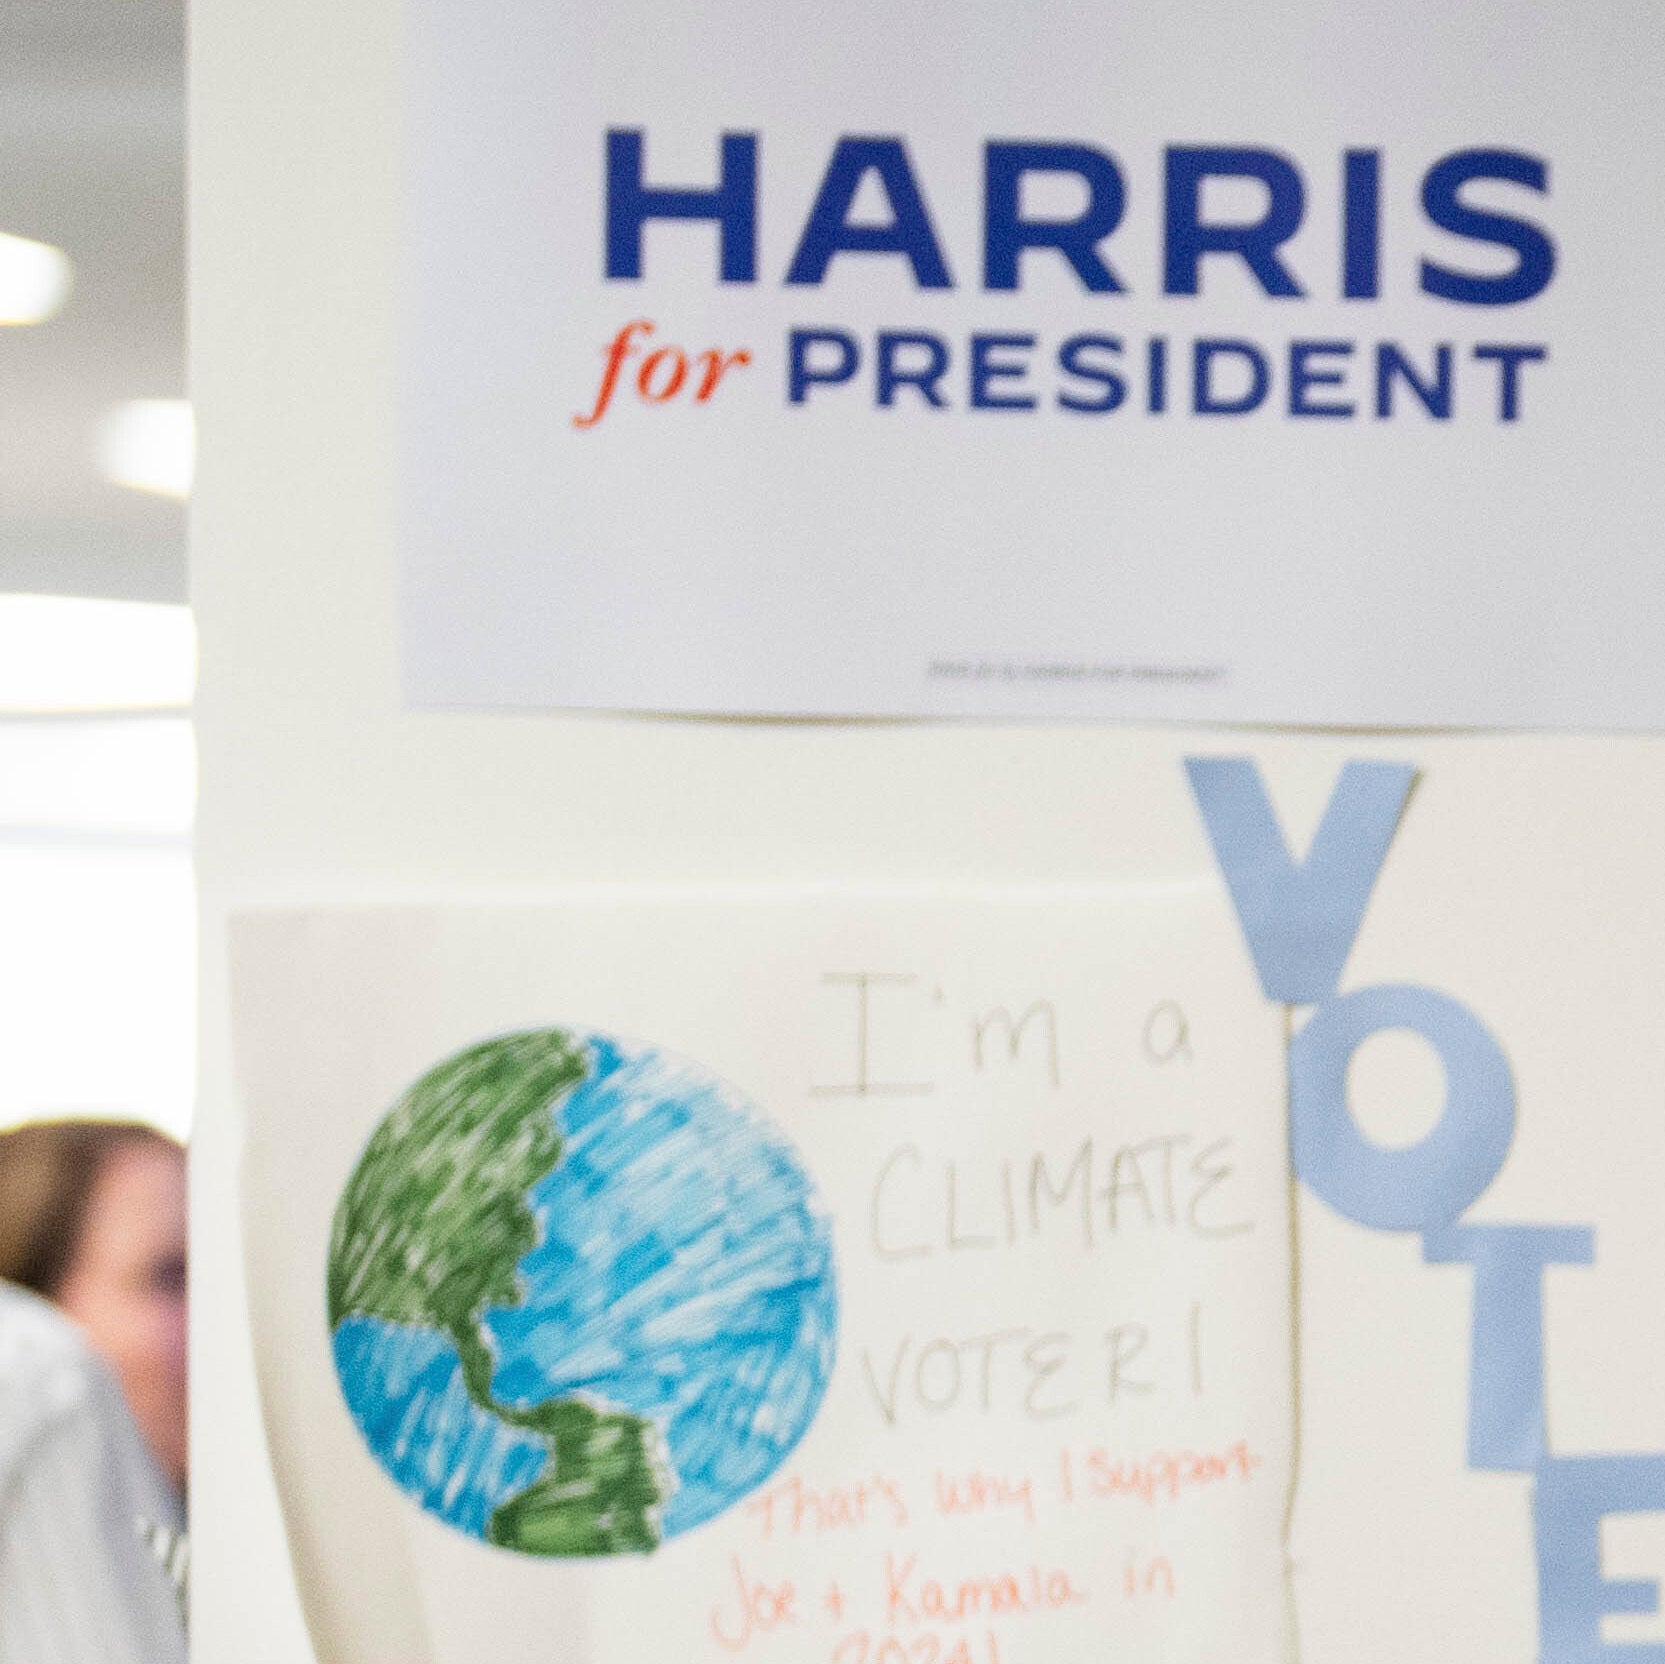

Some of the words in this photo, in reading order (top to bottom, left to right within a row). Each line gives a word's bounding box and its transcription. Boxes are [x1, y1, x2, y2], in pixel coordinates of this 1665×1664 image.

[600, 127, 1560, 309] HARRIS
[570, 318, 755, 430] for
[784, 326, 1550, 423] PRESIDENT
[808, 970, 1062, 1100] I'm
[1140, 997, 1196, 1069] a
[868, 1131, 1258, 1264] CLIMATE
[708, 1552, 797, 1653] Joe
[882, 1552, 1090, 1627] Kamala
[1122, 1555, 1178, 1600] in
